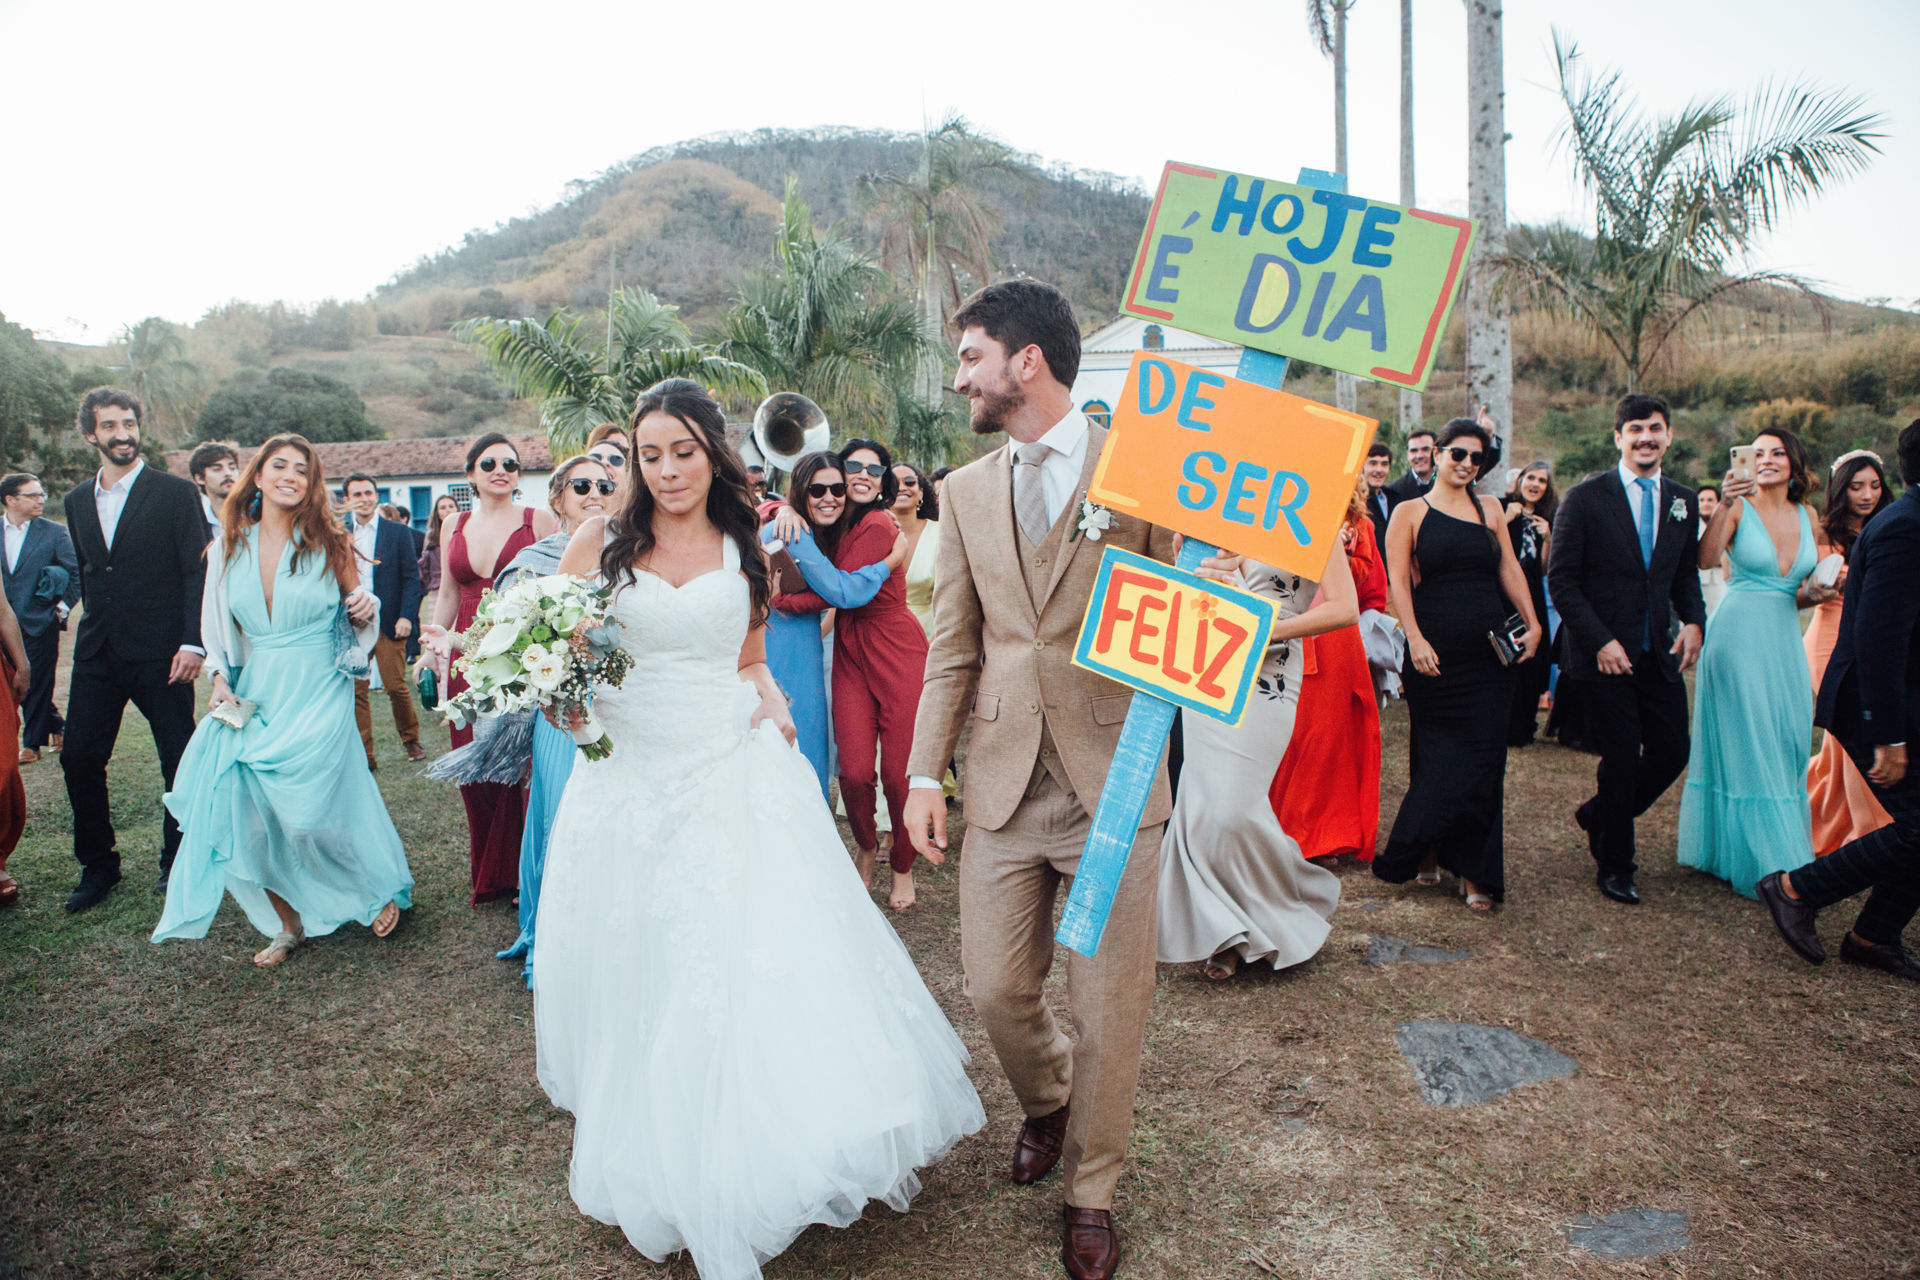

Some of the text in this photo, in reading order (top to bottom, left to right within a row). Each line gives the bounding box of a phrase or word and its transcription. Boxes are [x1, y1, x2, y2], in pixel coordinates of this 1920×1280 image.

[1211, 174, 1400, 268] HOJE
[1145, 211, 1387, 352] É DIA
[1136, 359, 1225, 432] DE
[1177, 450, 1312, 547] SER
